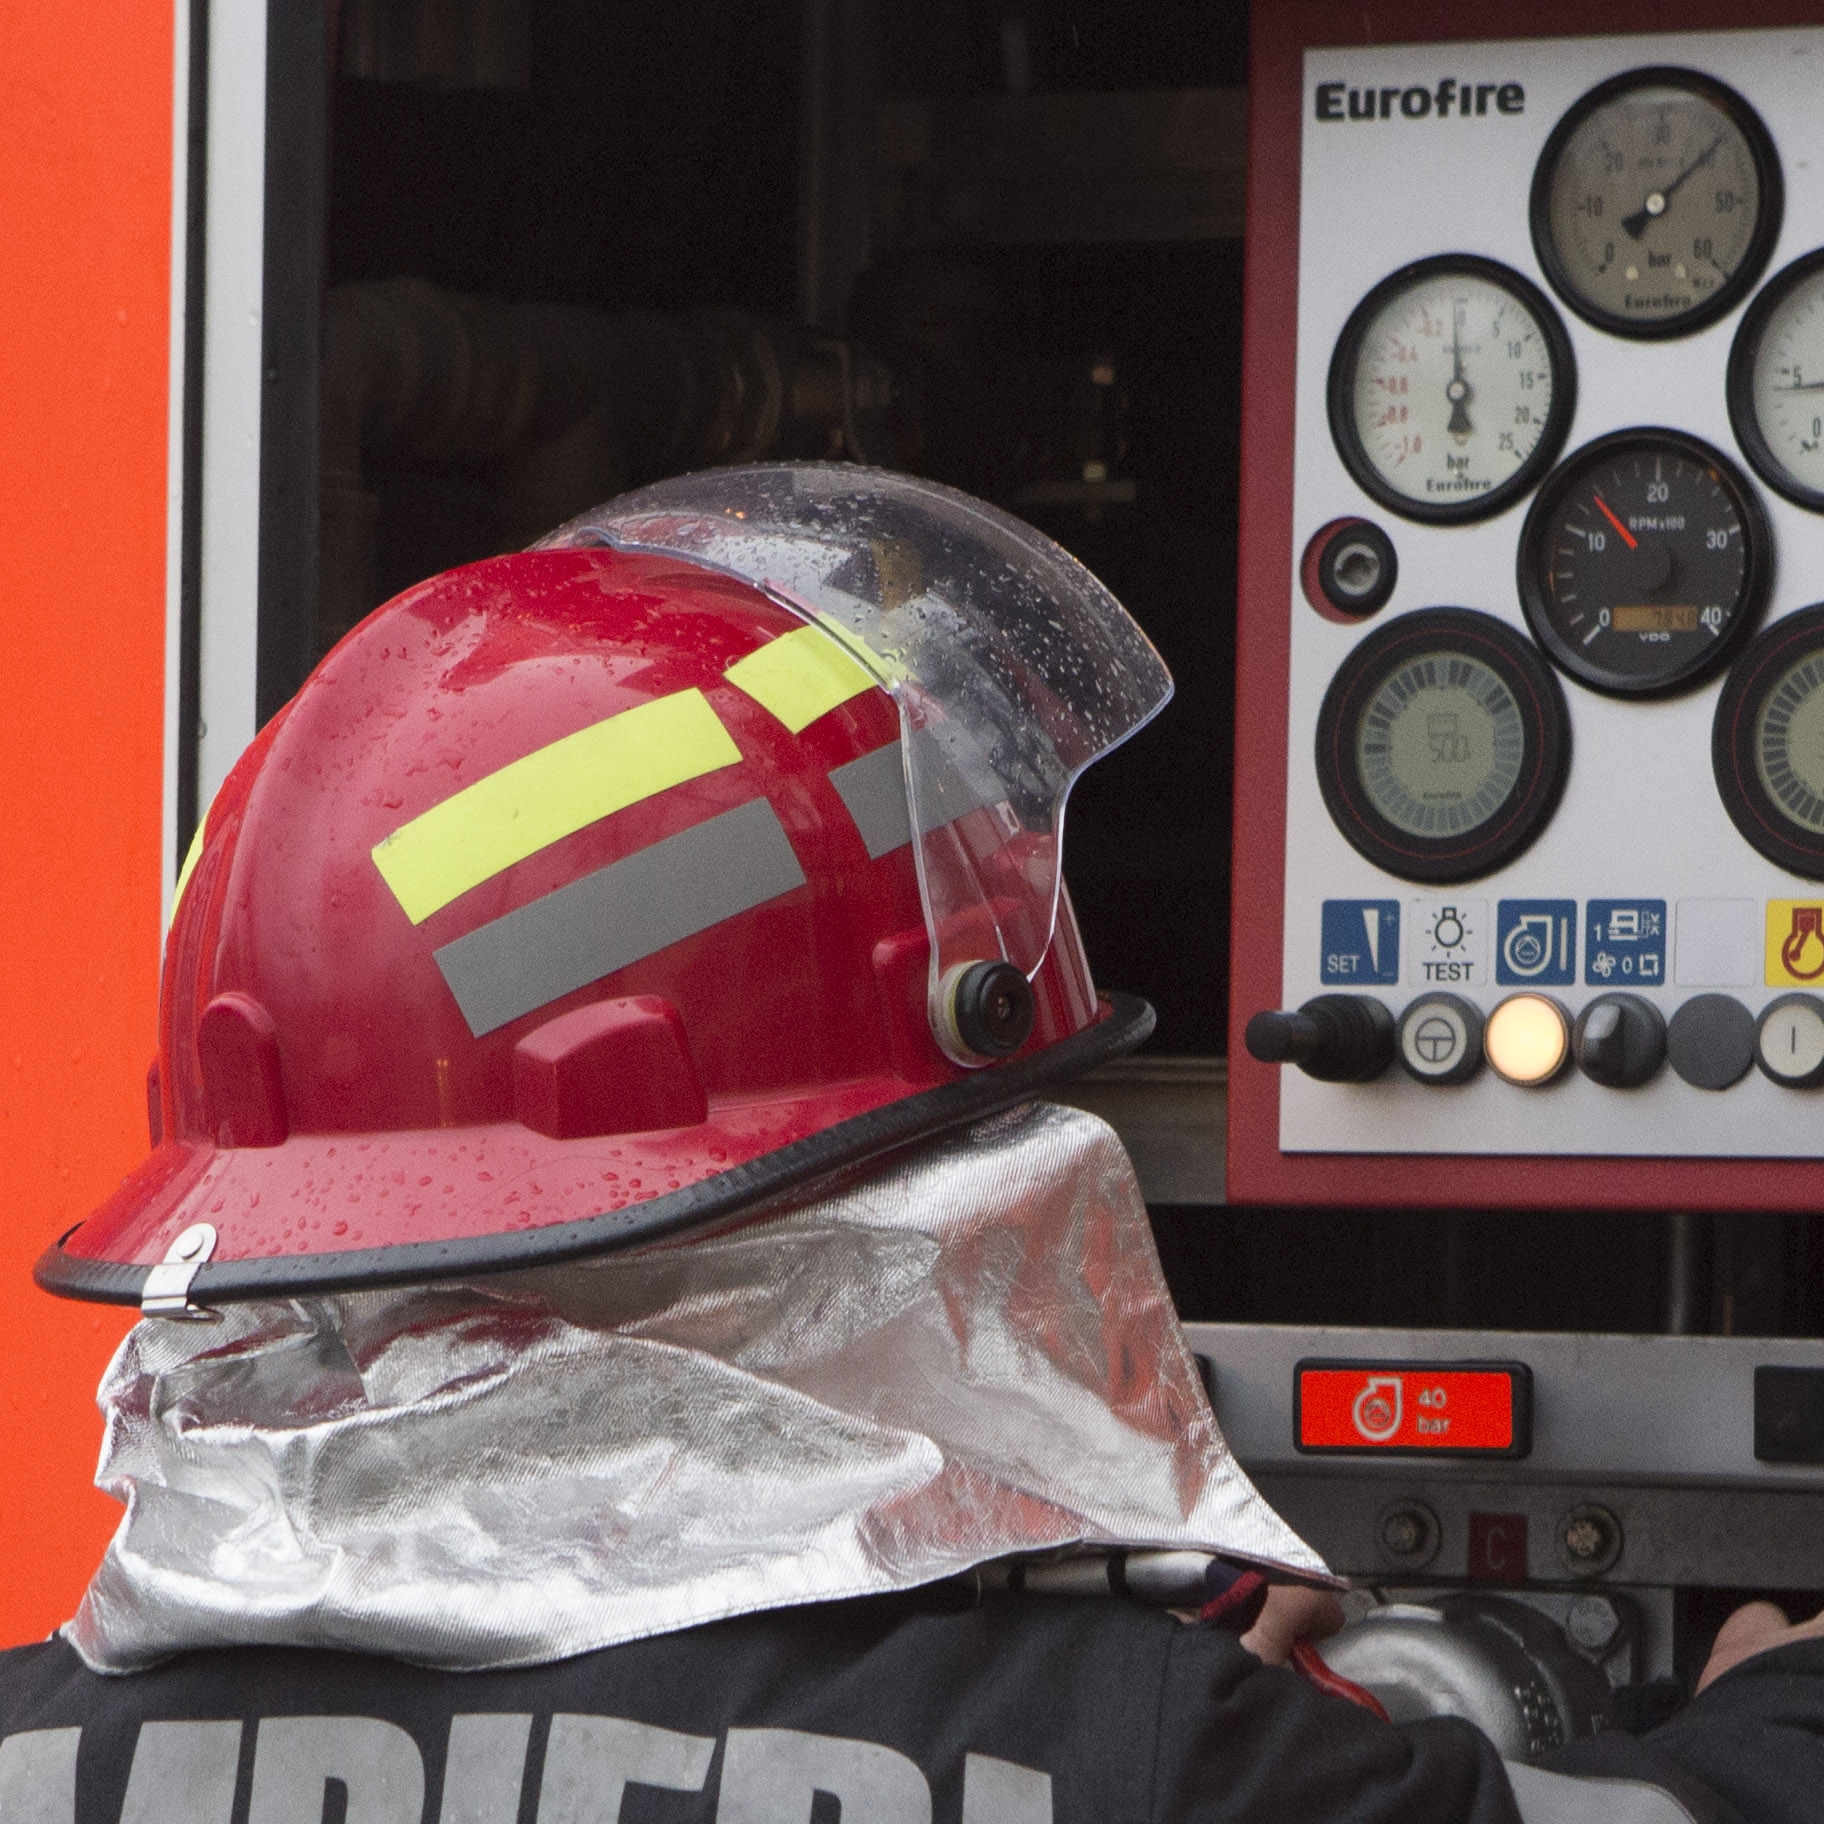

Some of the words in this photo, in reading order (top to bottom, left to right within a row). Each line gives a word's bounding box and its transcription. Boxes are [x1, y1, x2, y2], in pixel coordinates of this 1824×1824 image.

[1315, 76, 1526, 122] Eurofire
[1585, 196, 1603, 218] 10
[1715, 190, 1734, 213] 50
[1604, 242, 1615, 263] 0
[1647, 250, 1672, 268] bar
[1693, 238, 1712, 260] 60
[1507, 340, 1522, 359] 10
[1519, 371, 1535, 390] 15
[1792, 366, 1802, 388] 5
[1514, 405, 1530, 424] 20
[1812, 417, 1822, 438] 0
[1498, 432, 1514, 451] 25
[1446, 453, 1470, 470] bar
[1426, 478, 1492, 493] Eurofire
[1646, 483, 1670, 503] 20
[1588, 531, 1606, 552] 10
[1706, 529, 1727, 550] 30
[1598, 607, 1610, 627] 0
[1699, 606, 1722, 625] 40
[1639, 632, 1671, 643] VDO
[1327, 954, 1360, 973] SET
[1422, 962, 1475, 981] TEST
[1417, 1387, 1448, 1409] 40
[1416, 1413, 1451, 1434] bar
[1486, 1526, 1507, 1570] C
